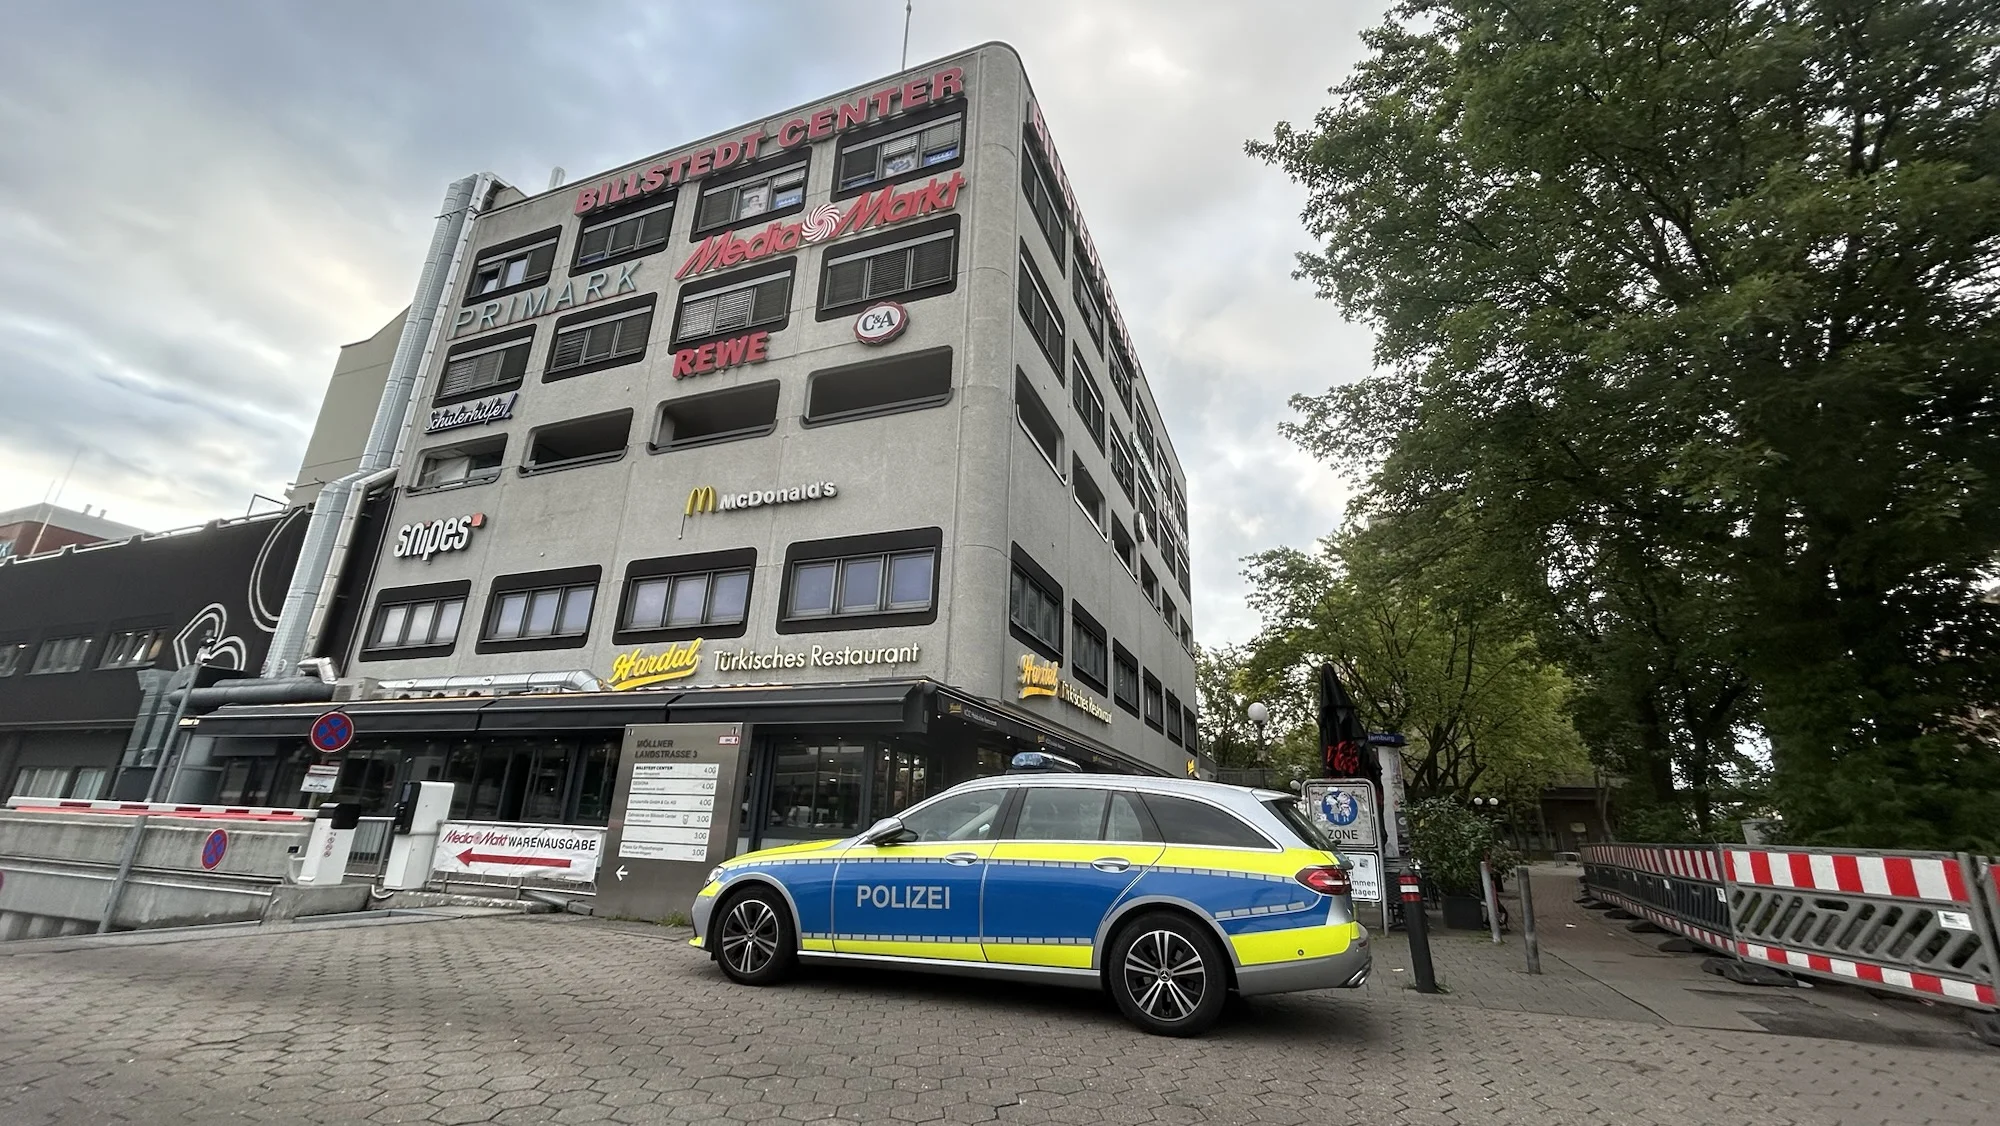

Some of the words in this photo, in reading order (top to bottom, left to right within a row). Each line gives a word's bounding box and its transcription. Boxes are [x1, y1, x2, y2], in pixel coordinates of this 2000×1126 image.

[573, 130, 769, 217] BILLSTEDT
[777, 66, 965, 149] CENTER
[1028, 97, 1102, 286] BILLSTEDT
[675, 228, 801, 281] Media
[836, 172, 966, 238] Markt
[453, 260, 643, 340] PRIMARK
[861, 310, 896, 334] C&A
[673, 331, 771, 380] REWE
[425, 392, 518, 435] Schülerhilfe!
[718, 480, 838, 513] McDonald's
[394, 513, 472, 562] snipes
[607, 638, 703, 691] Hardal
[713, 646, 806, 673] Türkisches
[809, 641, 920, 670] Restaurant
[634, 750, 692, 759] LANDSTRASSE
[692, 750, 698, 759] 3
[636, 739, 674, 748] MÖLLNER
[1367, 733, 1396, 743] amburg
[443, 830, 473, 844] Media
[479, 832, 508, 847] Markt
[508, 837, 597, 851] WARENAUSGABE
[1328, 829, 1358, 840] ZONE
[856, 884, 951, 910] POLIZEI
